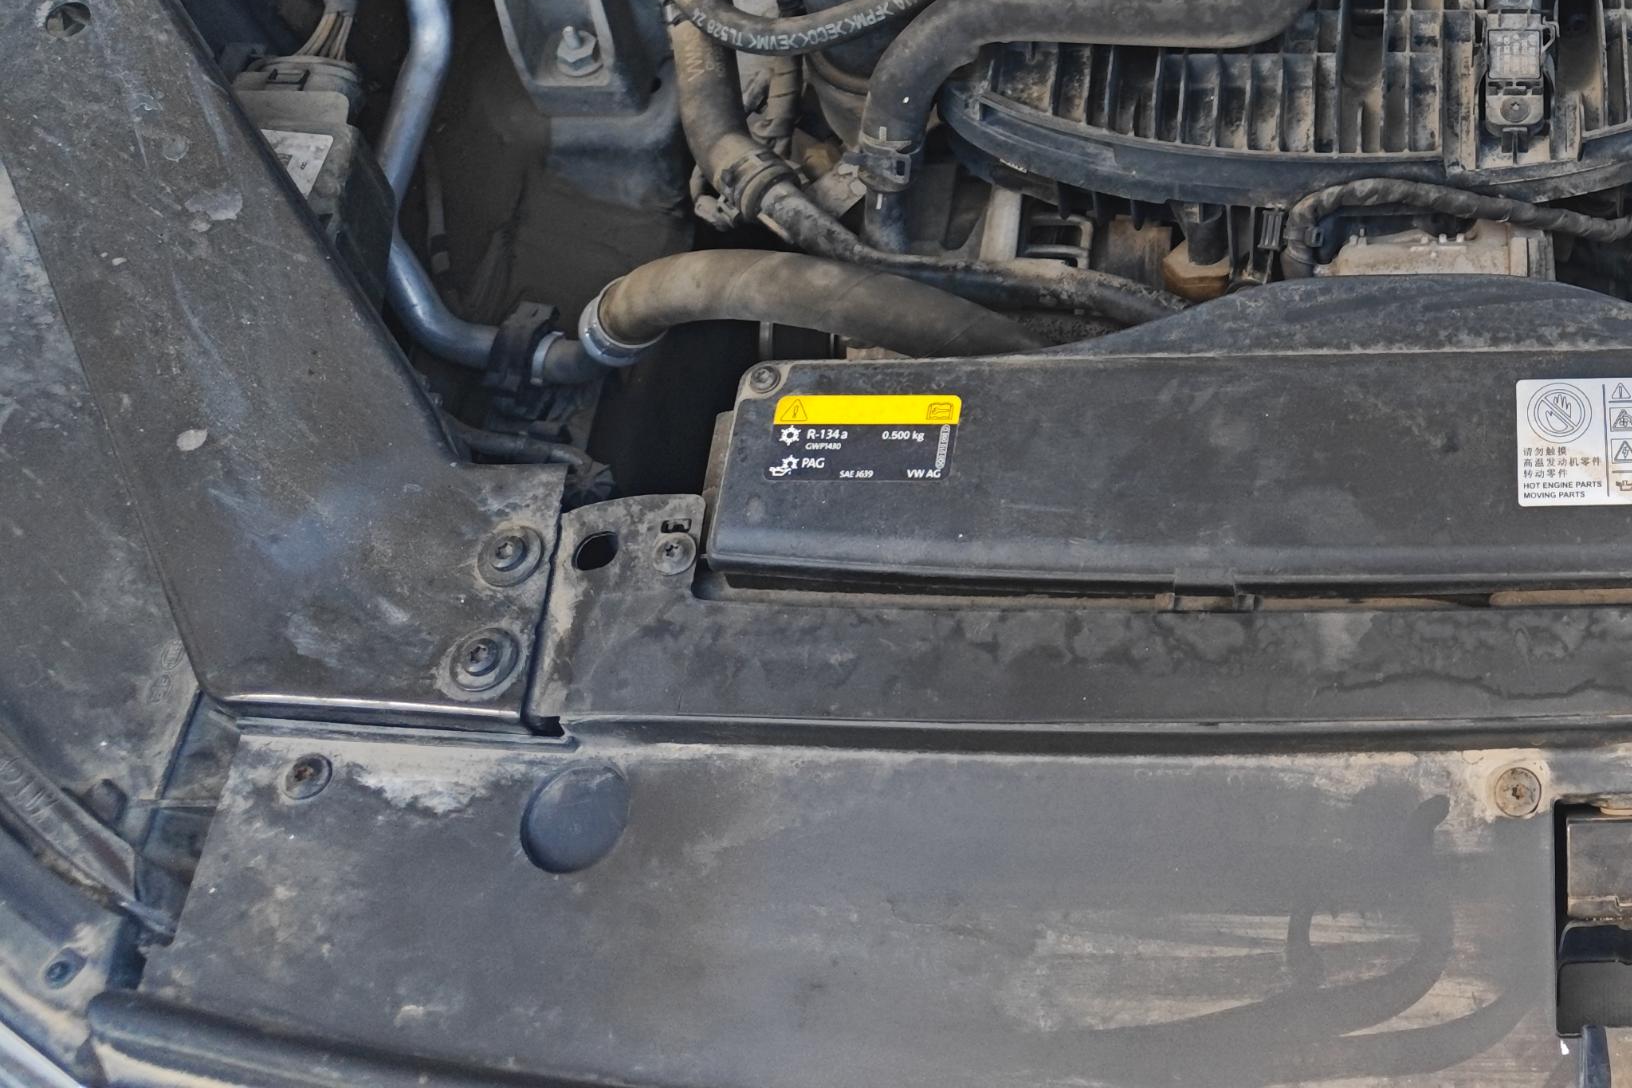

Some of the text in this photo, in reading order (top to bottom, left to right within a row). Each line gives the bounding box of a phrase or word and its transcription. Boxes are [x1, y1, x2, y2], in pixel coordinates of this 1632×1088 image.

[882, 430, 911, 440] 0.500
[912, 430, 925, 442] kg
[1523, 446, 1567, 456] 请勿触摸
[801, 457, 825, 469] PAG
[1523, 456, 1602, 467] 高温发动机零件
[839, 469, 855, 478] SAE
[906, 469, 941, 478] VW AG
[1523, 467, 1568, 479] 转动零件
[1523, 480, 1602, 490] HOT ENGINE PARTS
[1523, 491, 1557, 499] MOVING
